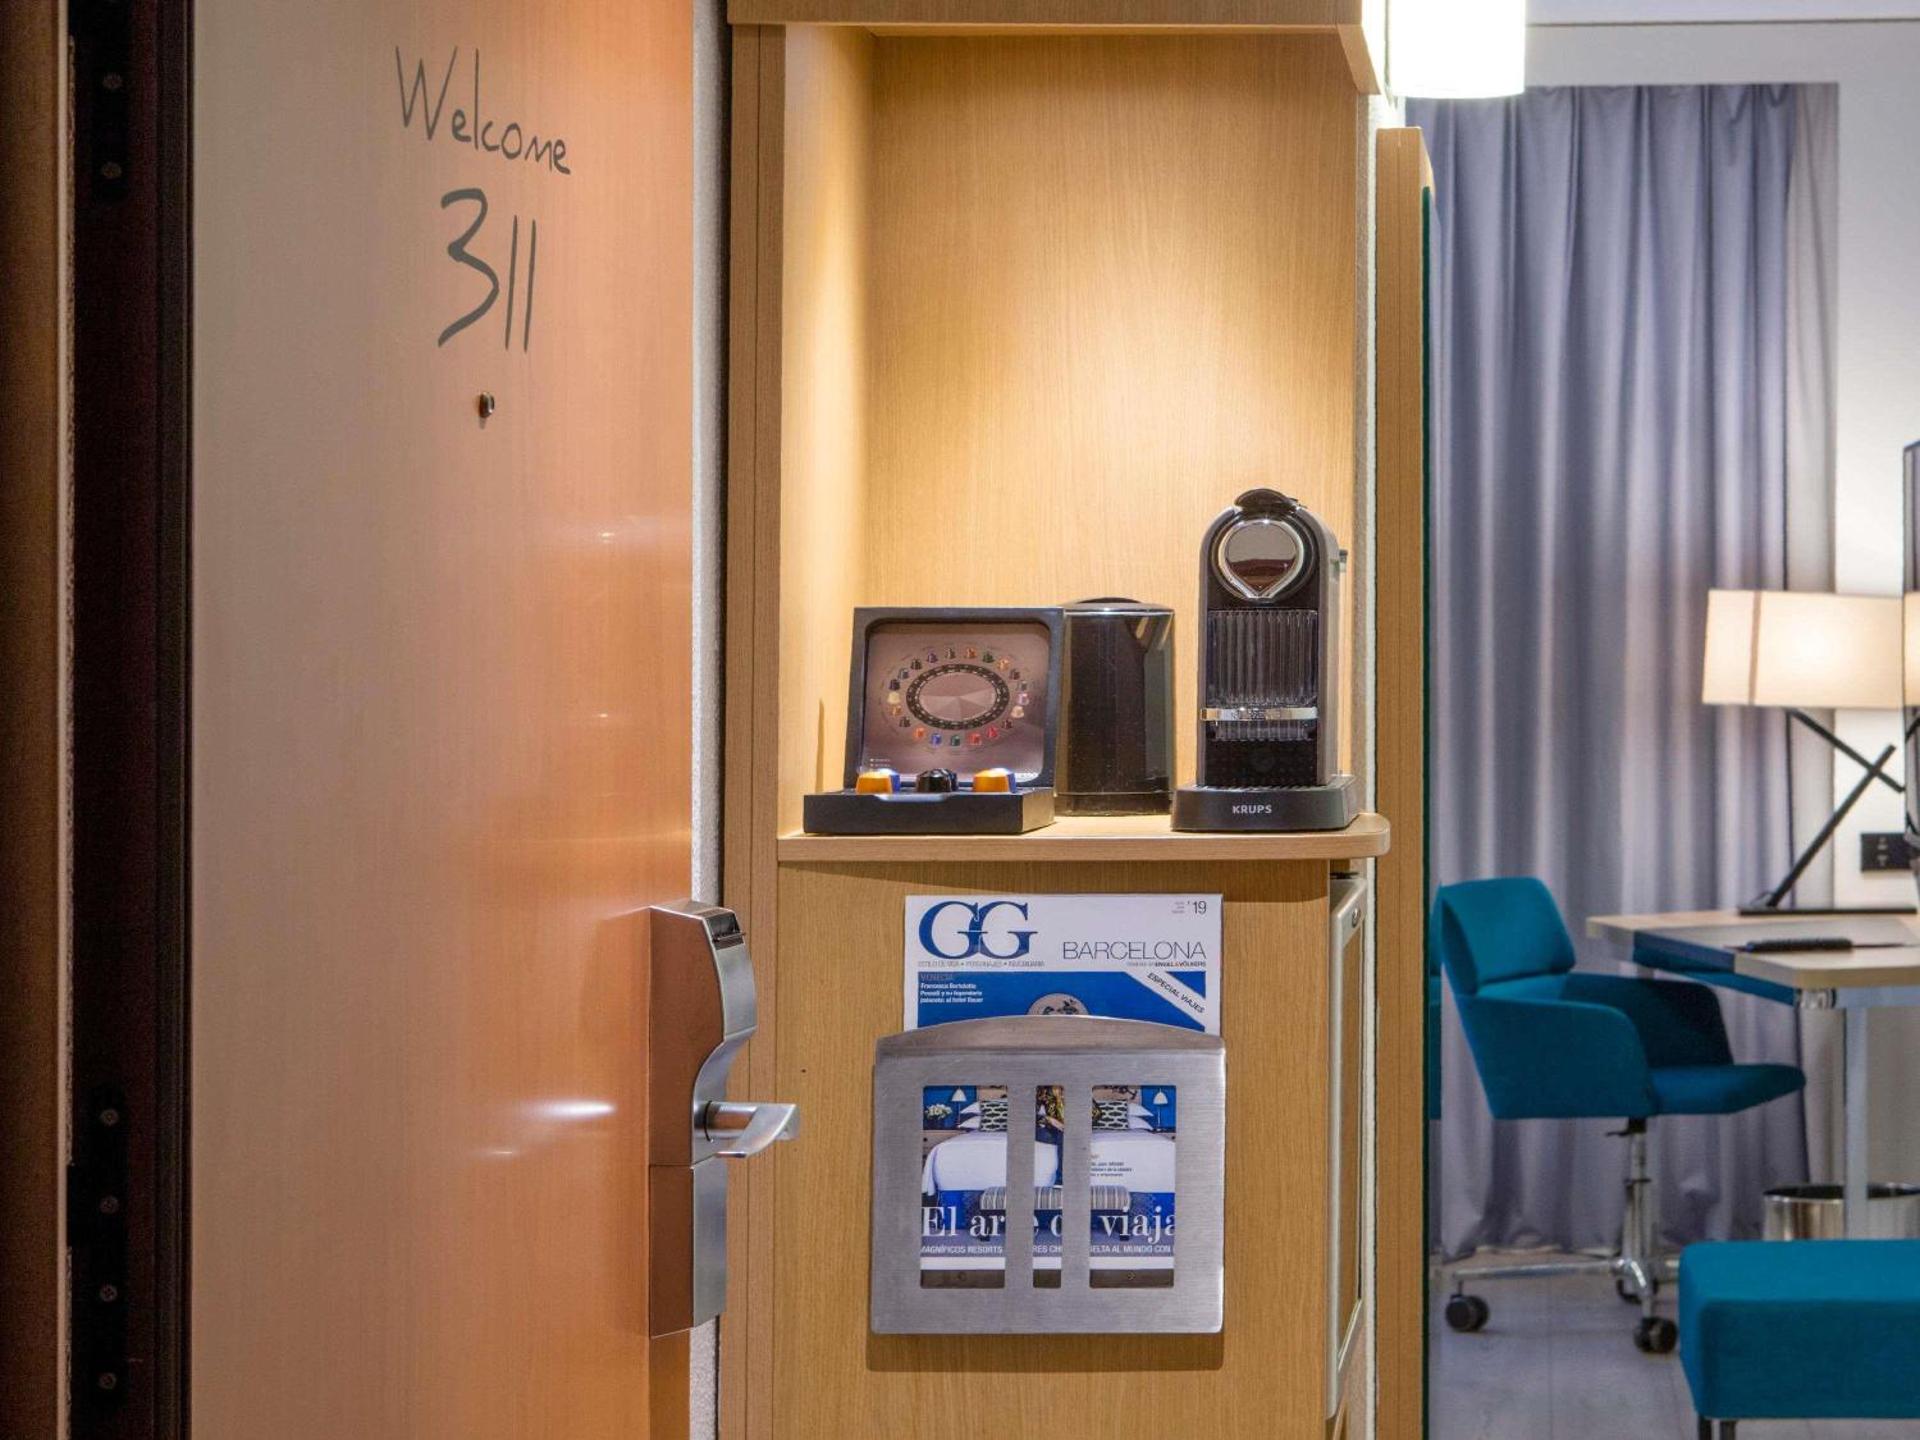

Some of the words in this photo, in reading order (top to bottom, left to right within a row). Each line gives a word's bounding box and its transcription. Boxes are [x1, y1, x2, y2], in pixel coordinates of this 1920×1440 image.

[394, 45, 571, 175] Welcome
[437, 187, 537, 353] 311
[1232, 804, 1272, 814] KRUPS
[1062, 941, 1207, 960] BARCELONA
[1147, 972, 1180, 998] ESPECIAL
[1180, 993, 1206, 1014] VIAJES
[922, 1206, 959, 1237] El
[1123, 1244, 1153, 1253] MUNDO
[1154, 1244, 1171, 1253] CON
